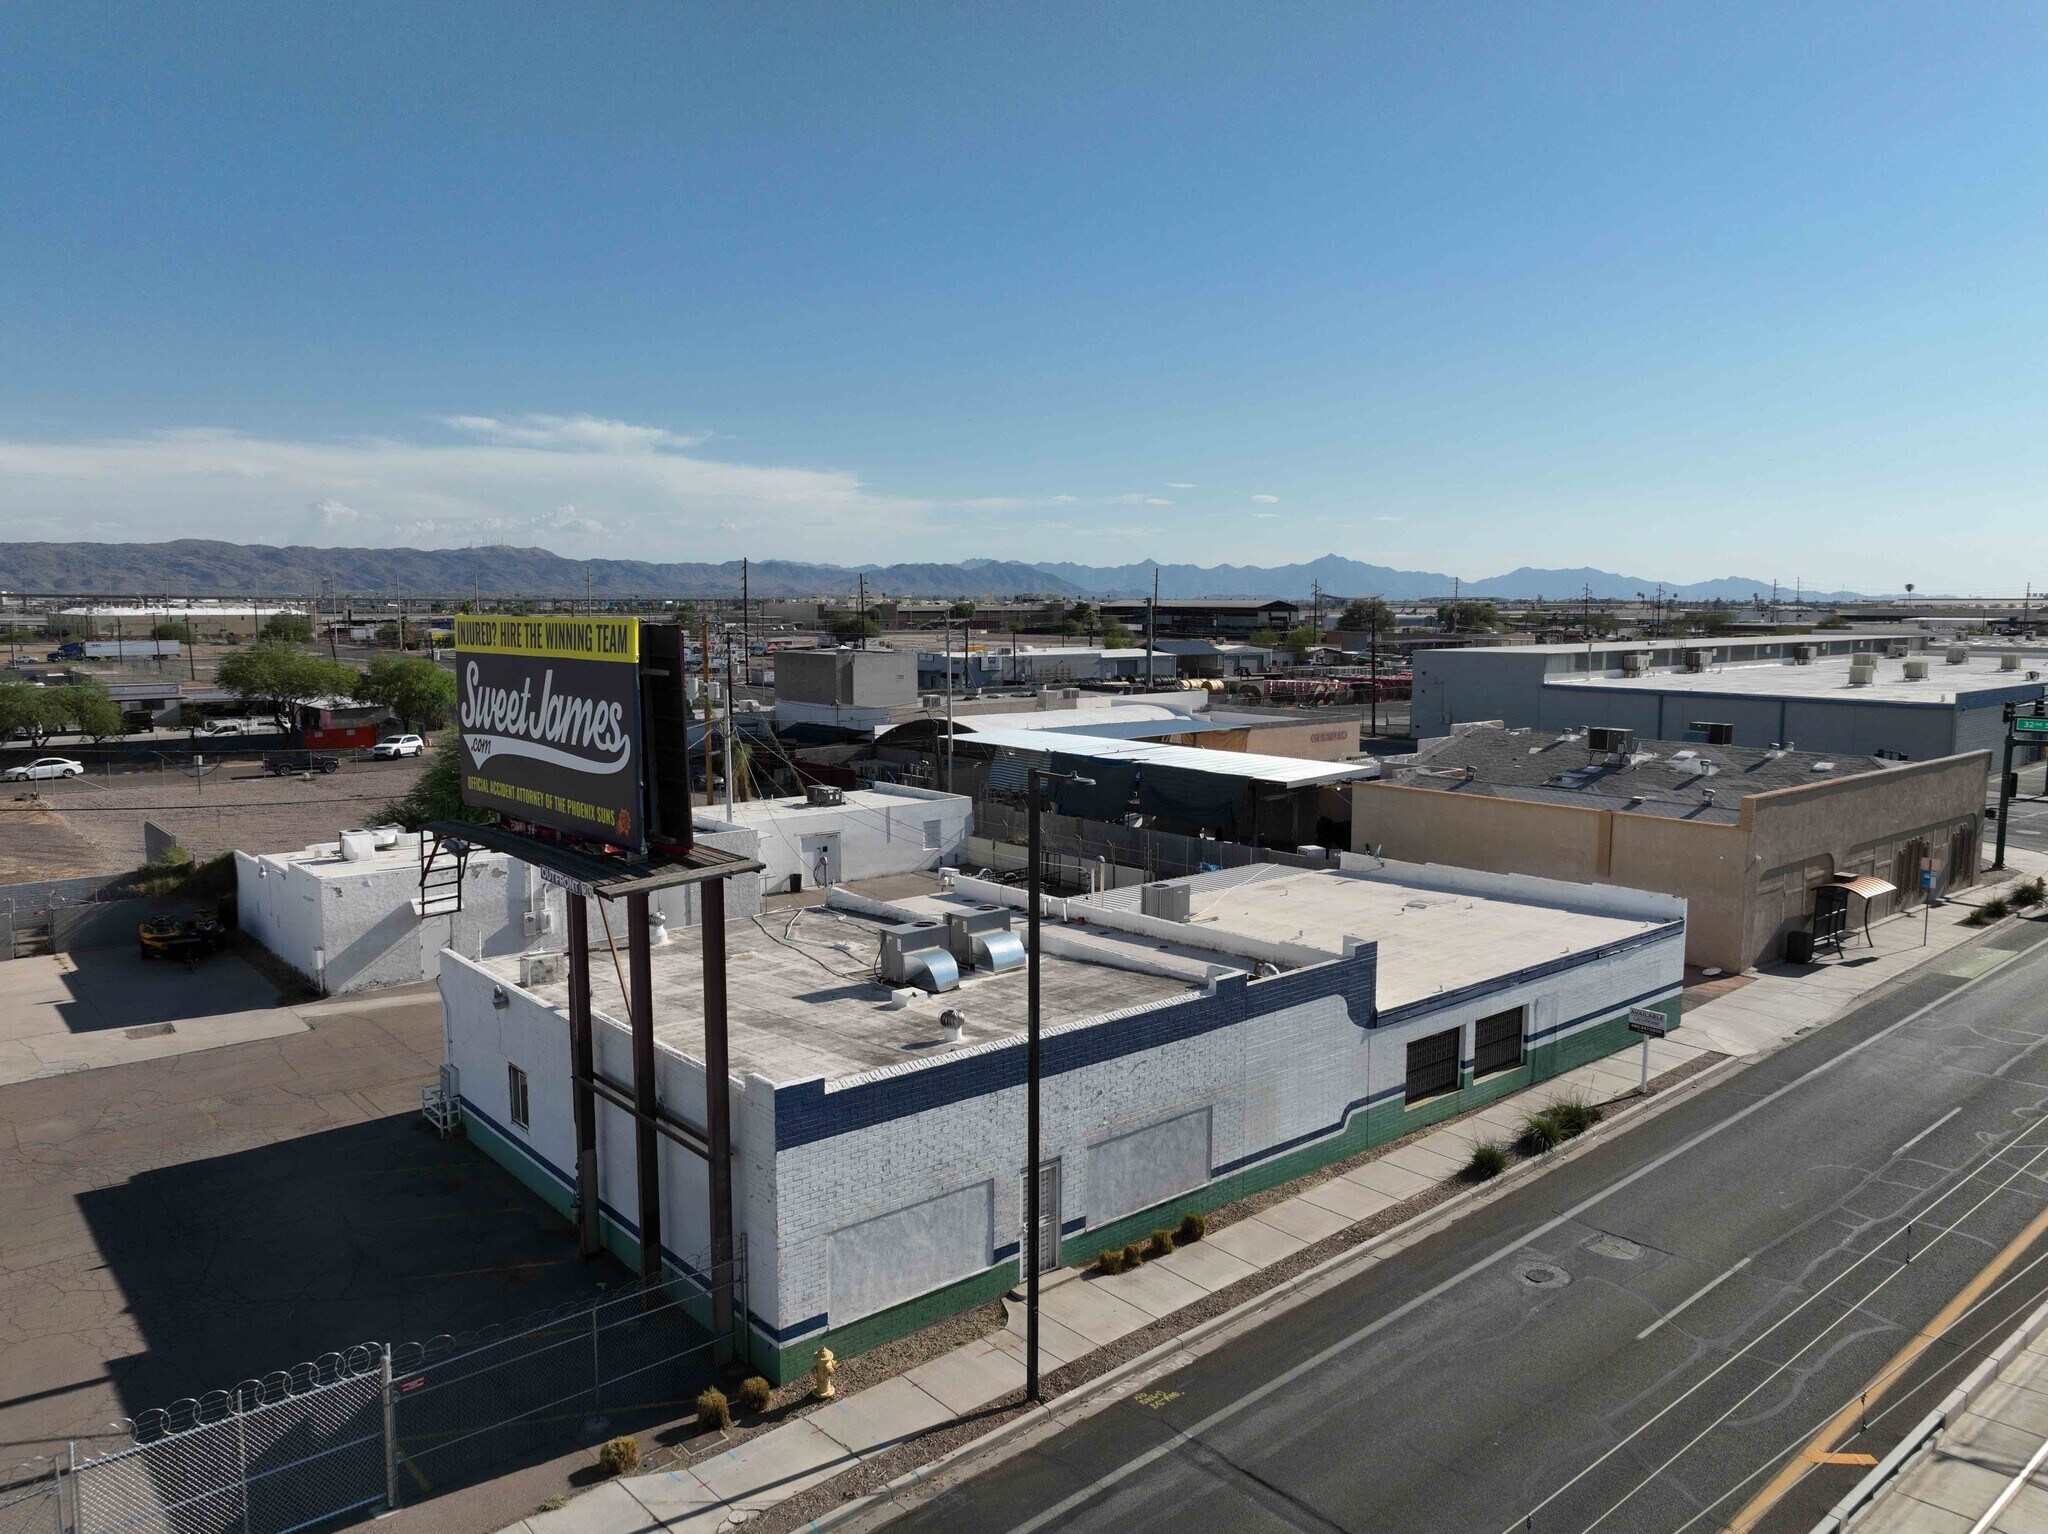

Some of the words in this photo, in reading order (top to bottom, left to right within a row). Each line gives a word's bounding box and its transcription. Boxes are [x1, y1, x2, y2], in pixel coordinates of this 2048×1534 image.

[458, 621, 497, 647] INJURED?
[500, 623, 521, 648] HIRE
[524, 623, 542, 649] THE
[545, 623, 592, 652] WINNING
[596, 624, 628, 654] TEAM
[461, 660, 531, 736] Sweet
[529, 669, 624, 753] James
[471, 737, 492, 755] .com
[467, 775, 489, 794] OFFICIAL
[490, 780, 515, 800] ACCIDENT
[516, 787, 544, 807] ATTORNEY
[545, 793, 554, 810] OF
[554, 796, 566, 814] THE
[567, 799, 595, 820] PHOENIX
[597, 806, 616, 827] SUNS
[541, 867, 580, 893] OUTFRONT
[1630, 1009, 1664, 1021] AVAILABLE
